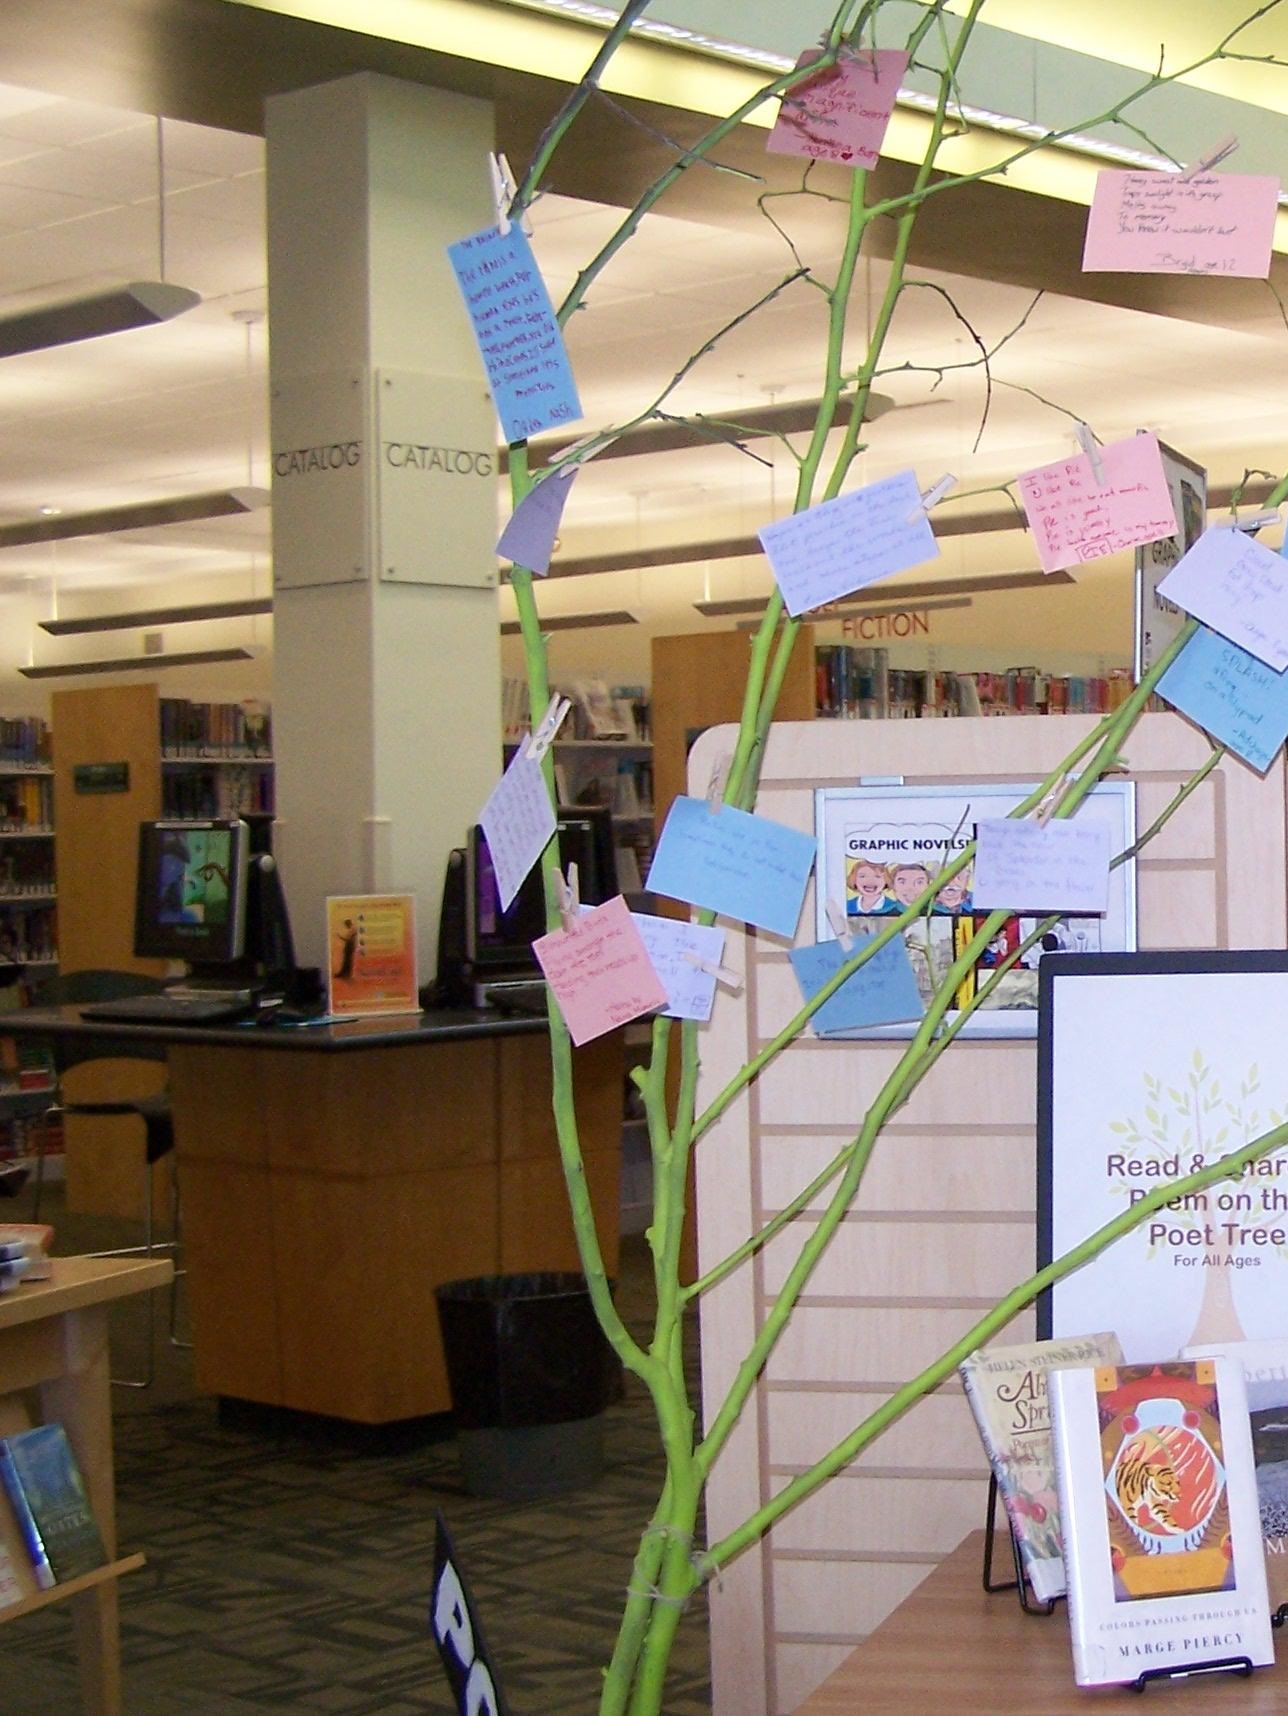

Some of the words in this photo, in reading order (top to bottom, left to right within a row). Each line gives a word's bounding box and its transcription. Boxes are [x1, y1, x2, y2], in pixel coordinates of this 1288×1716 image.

[275, 444, 361, 477] CATALOG
[387, 446, 494, 477] CATALOG
[842, 611, 929, 639] FICTION
[849, 839, 909, 850] GRAPHIC
[1107, 1154, 1179, 1177] Read
[1130, 1189, 1208, 1211] Pem
[1218, 1194, 1252, 1211] on
[1150, 1224, 1213, 1246] Poet
[1222, 1224, 1286, 1246] Tree
[1174, 1254, 1196, 1267] For
[1202, 1253, 1220, 1267] All
[1224, 1254, 1261, 1269] Ages
[1100, 1621, 1142, 1631] COLORS
[1145, 1615, 1188, 1626] PASSING
[1193, 1610, 1240, 1621] THROUGH
[1119, 1640, 1176, 1657] MARGE
[1184, 1632, 1244, 1651] PIERCY
